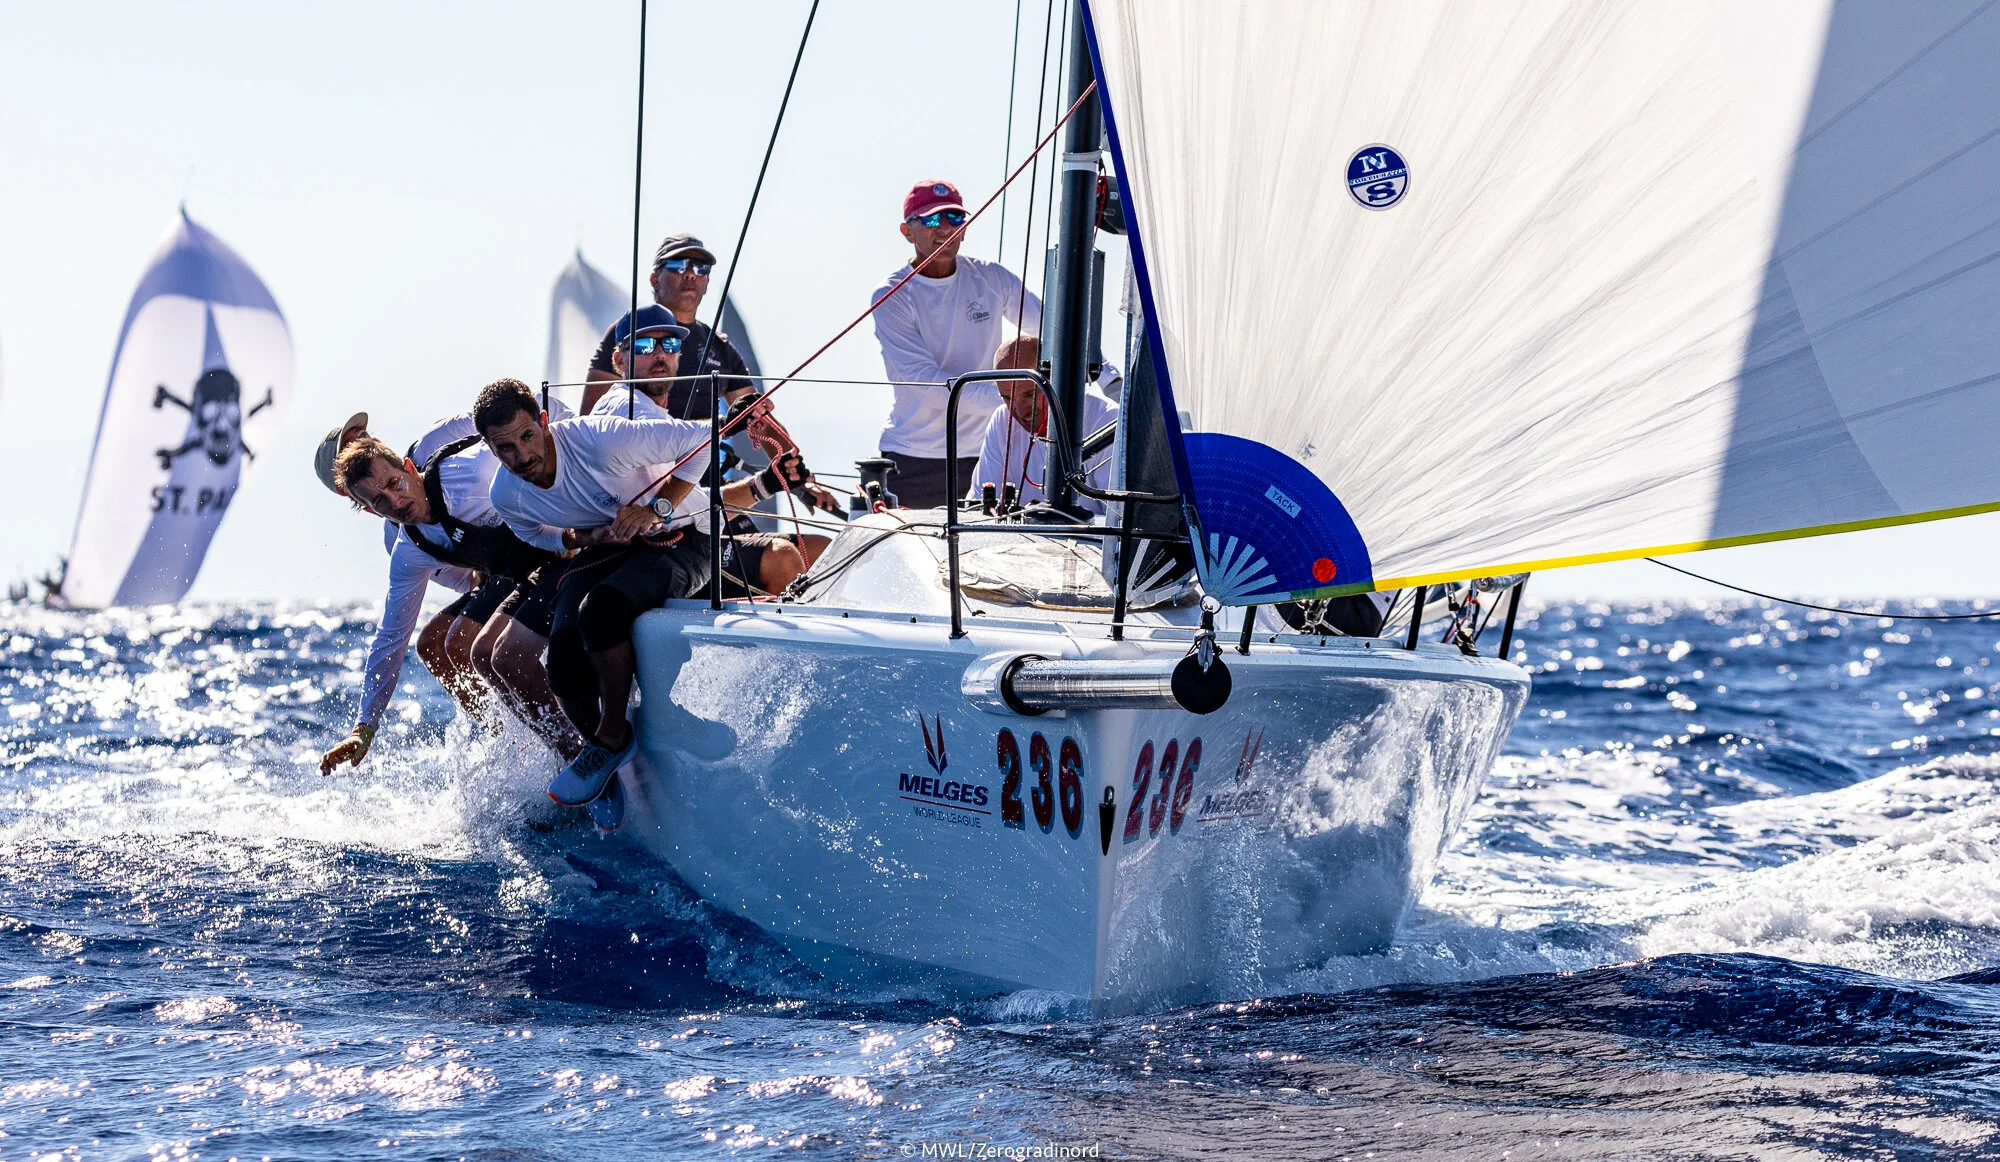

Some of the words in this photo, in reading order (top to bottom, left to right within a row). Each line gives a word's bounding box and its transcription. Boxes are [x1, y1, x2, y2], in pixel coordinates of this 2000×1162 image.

[1358, 151, 1388, 173] N
[1366, 181, 1397, 202] S
[1272, 490, 1295, 512] TACK
[899, 773, 989, 806] MELGES
[997, 726, 1085, 840] 236
[1123, 736, 1202, 845] 236
[913, 806, 944, 821] WORLD
[947, 812, 982, 829] LEAGUE
